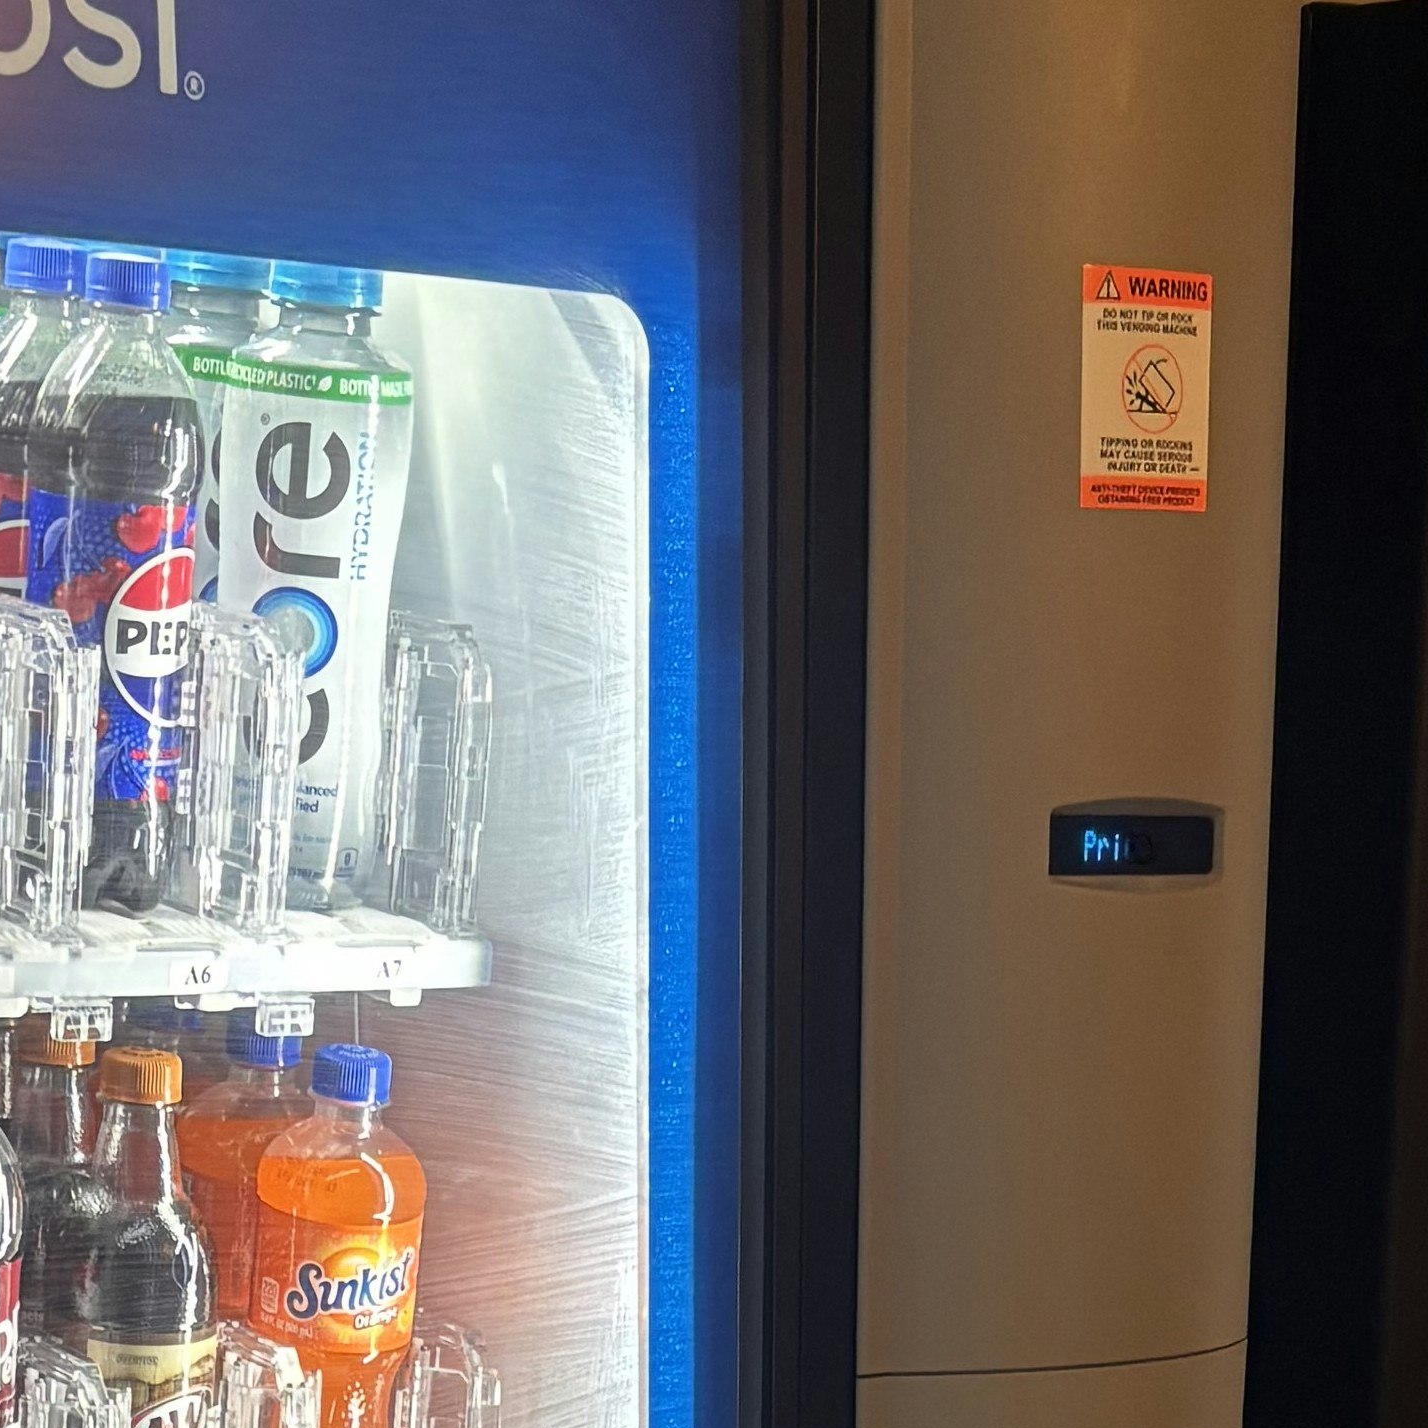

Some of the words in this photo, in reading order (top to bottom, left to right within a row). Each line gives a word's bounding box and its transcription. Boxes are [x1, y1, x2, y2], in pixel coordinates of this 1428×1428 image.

[1129, 276, 1208, 302] WARNING
[1120, 310, 1138, 320] NOT
[1100, 449, 1121, 460] MAY
[184, 962, 211, 985] A6
[286, 1249, 414, 1320] Sunkist
